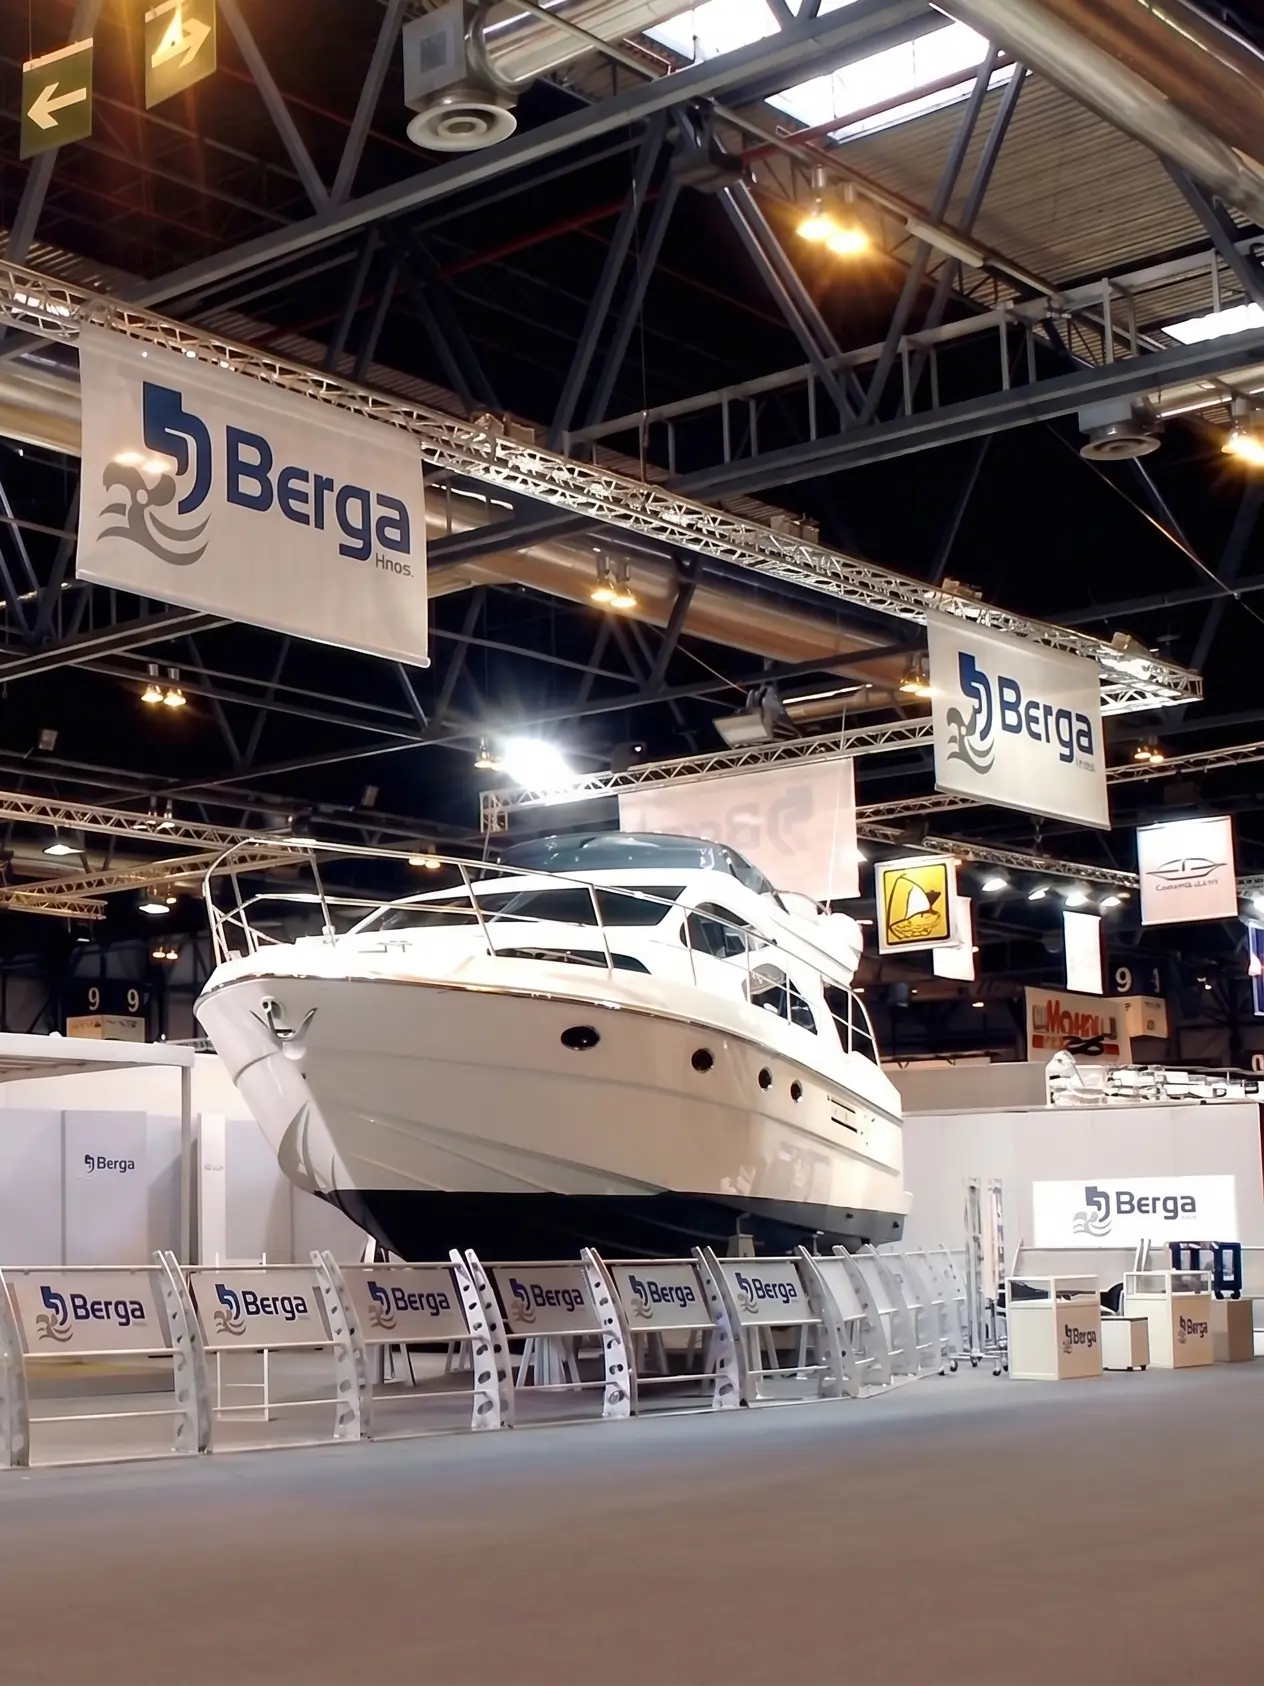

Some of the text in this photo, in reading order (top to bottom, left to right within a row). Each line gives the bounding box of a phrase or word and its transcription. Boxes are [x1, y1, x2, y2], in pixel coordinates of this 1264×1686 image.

[226, 425, 410, 561] Berga
[997, 676, 1094, 763] Berga
[1115, 967, 1131, 992] 9
[89, 987, 100, 1011] 9
[127, 988, 139, 1012] 9
[97, 1156, 135, 1173] Berga
[1115, 1191, 1196, 1220] Berga
[390, 1287, 450, 1316] Berga
[530, 1284, 584, 1312] Berga
[647, 1281, 695, 1308] Berga
[752, 1278, 797, 1303] Berga
[70, 1293, 145, 1326] Berga
[241, 1290, 308, 1321] Berga
[1073, 1328, 1097, 1347] Berga
[1187, 1319, 1208, 1338] Berga
